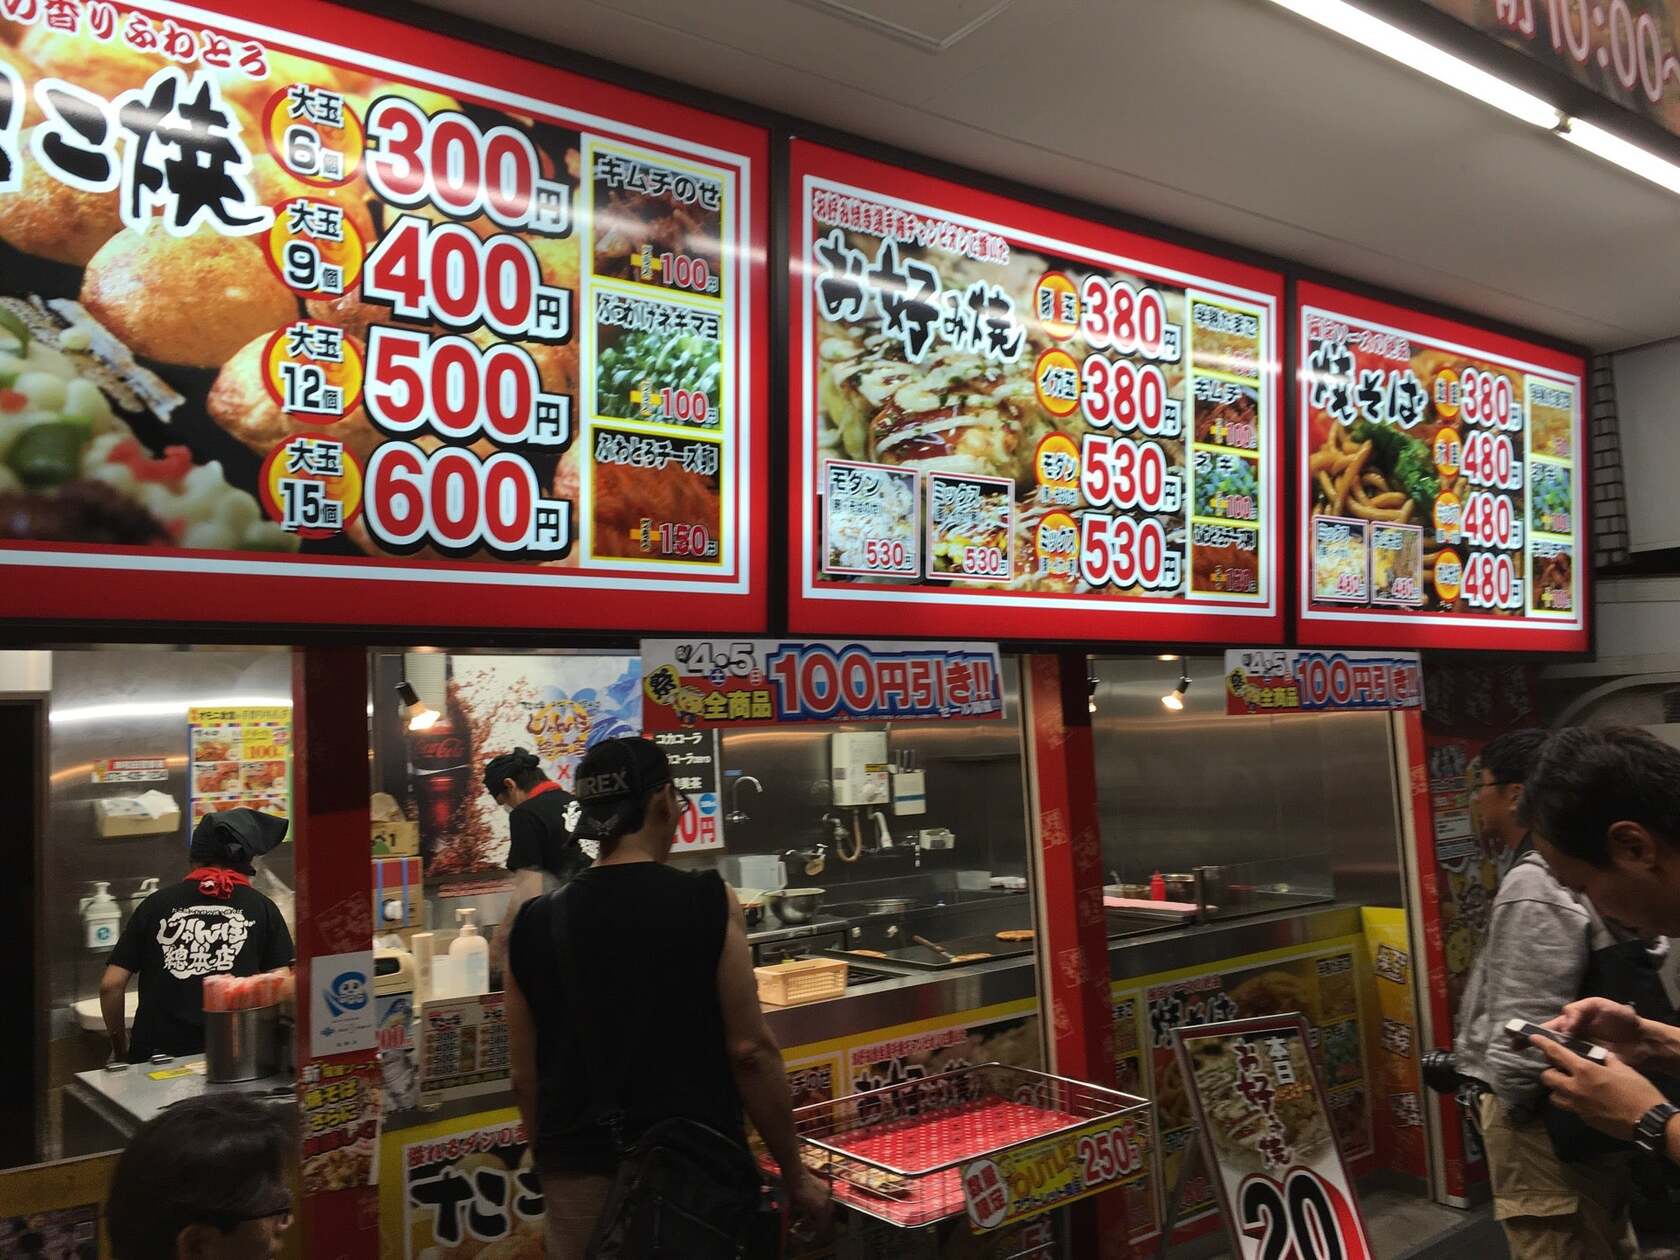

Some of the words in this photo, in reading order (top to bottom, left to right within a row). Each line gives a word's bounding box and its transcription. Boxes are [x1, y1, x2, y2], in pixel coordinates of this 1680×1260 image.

[288, 84, 344, 127] 大玉
[370, 100, 568, 232] 300円
[595, 156, 721, 211] キムチのせ
[287, 200, 344, 241] 大玉
[370, 220, 568, 333] 400円
[816, 230, 1026, 363] お好み焼
[287, 323, 344, 363] 大玉
[1083, 278, 1181, 361] 380円
[281, 362, 344, 414] 12個
[370, 328, 568, 441] 500円
[1083, 356, 1181, 435] 380円
[1310, 341, 1428, 429] 焼そば
[1462, 368, 1522, 431] 380円
[287, 439, 344, 475] 大玉
[832, 470, 879, 496] モダン
[1085, 437, 1181, 511] 530円
[1461, 431, 1523, 489] 480円
[281, 478, 344, 531] 15個
[370, 444, 568, 547] 600円
[1461, 492, 1523, 549] 480円
[866, 539, 914, 568] 530円
[963, 547, 1007, 574] 530円
[1085, 515, 1181, 588] 530円
[1461, 552, 1523, 608] 480円
[704, 691, 771, 719] 全商品
[671, 800, 717, 843] 0円
[163, 943, 235, 971] 総本店
[1264, 1036, 1296, 1085] 本日
